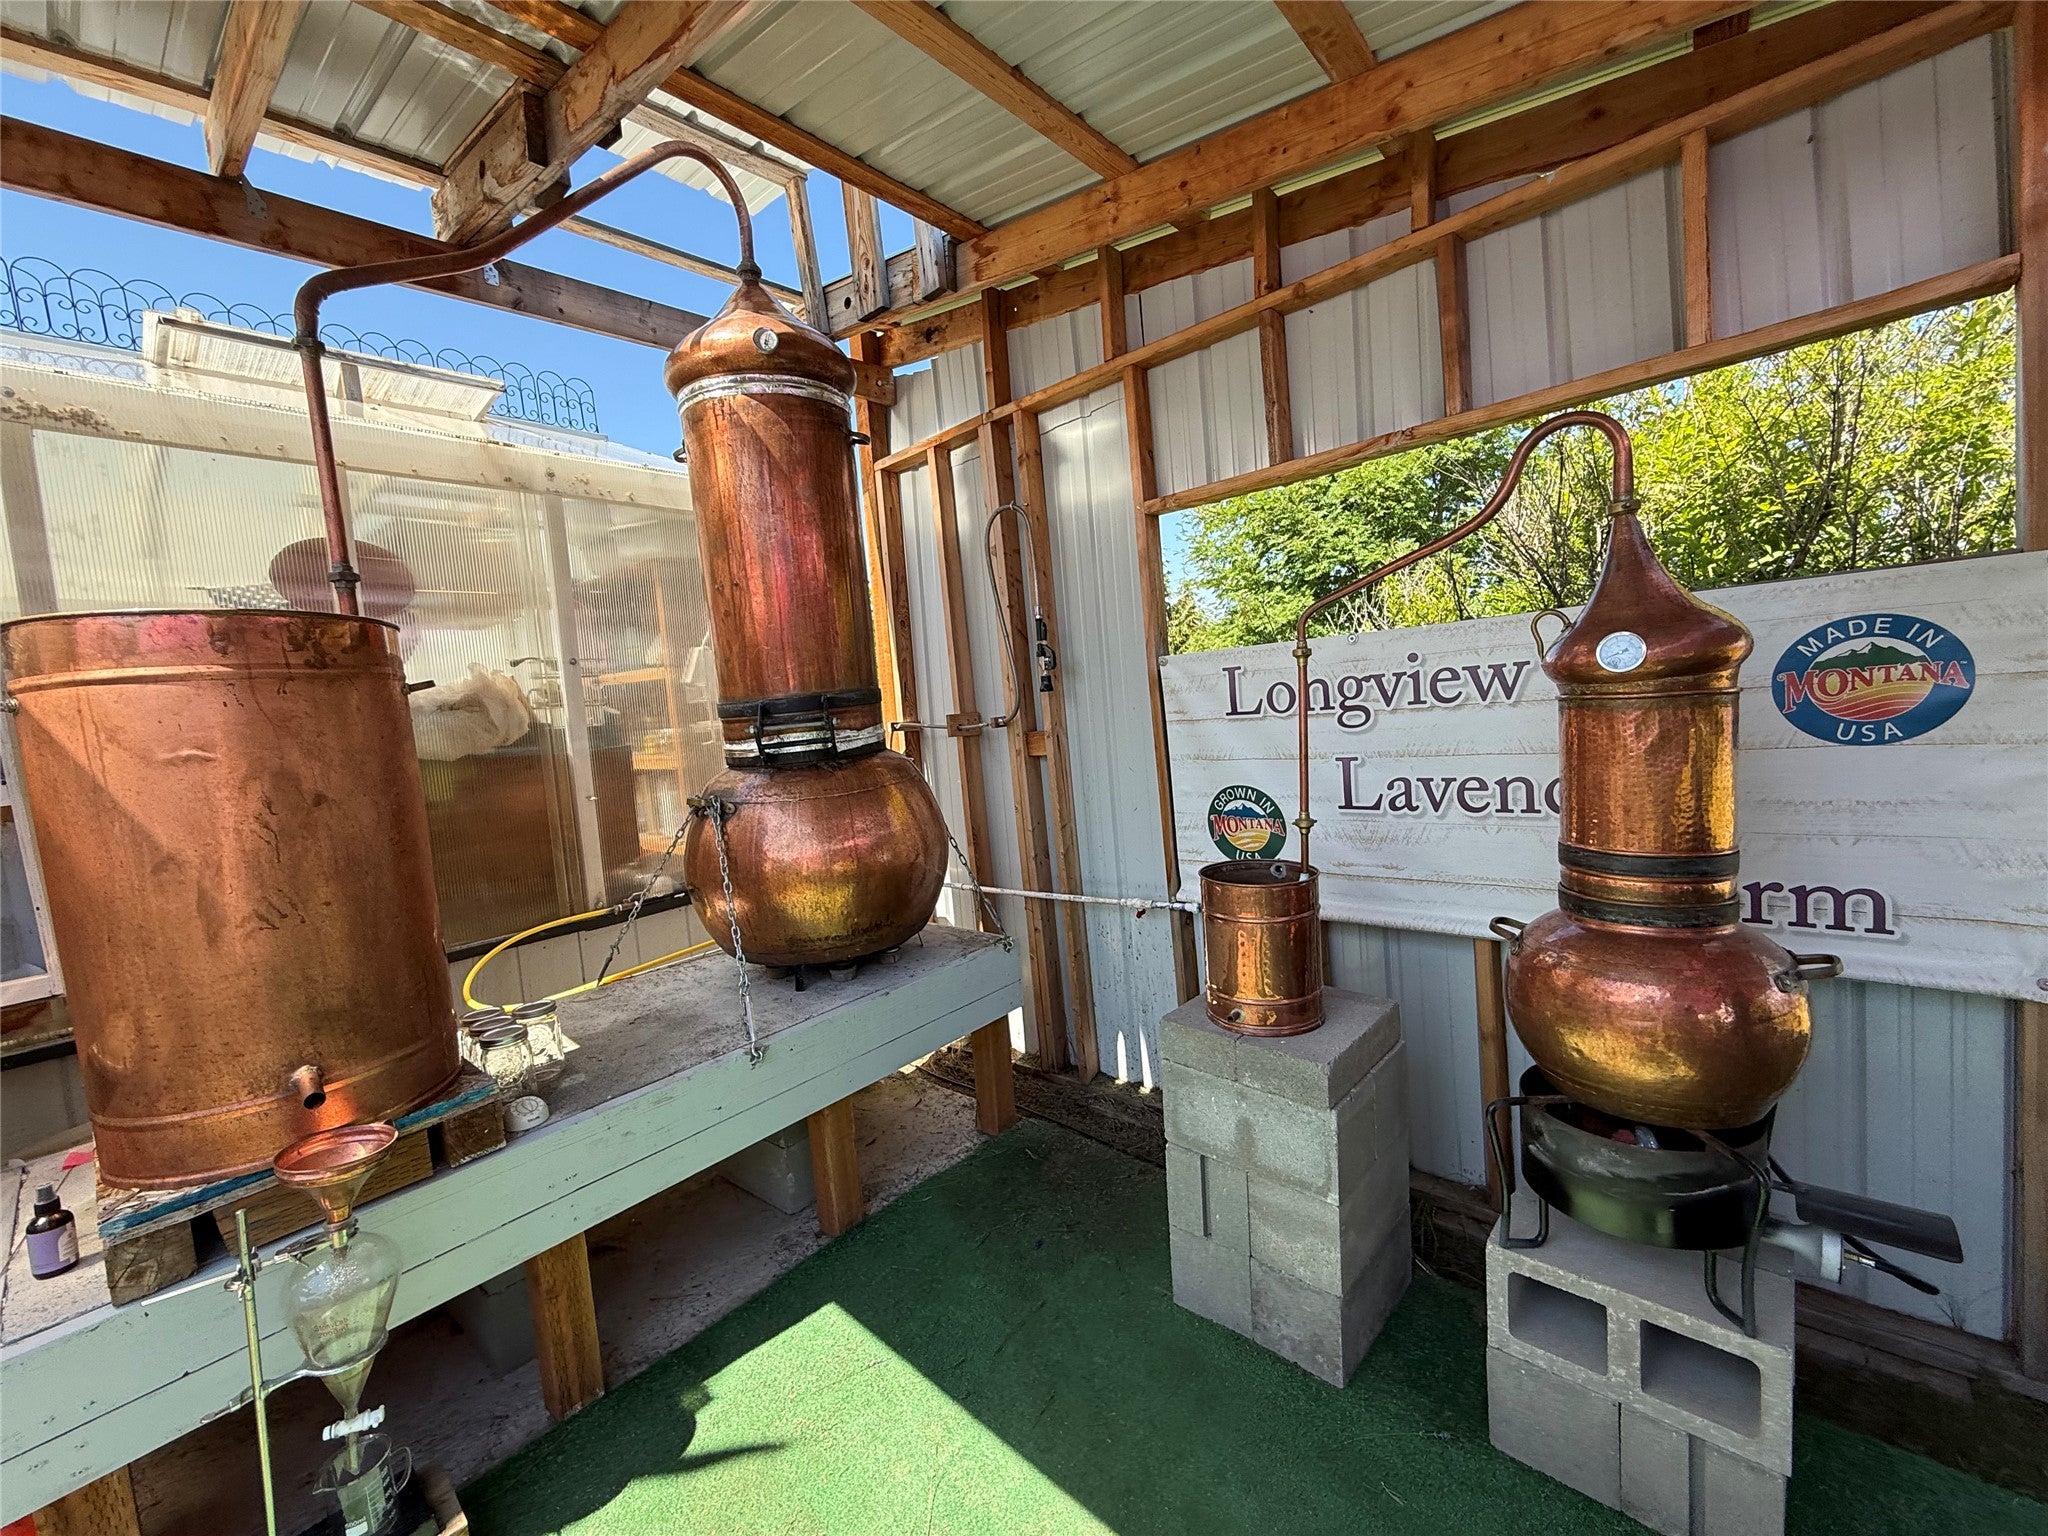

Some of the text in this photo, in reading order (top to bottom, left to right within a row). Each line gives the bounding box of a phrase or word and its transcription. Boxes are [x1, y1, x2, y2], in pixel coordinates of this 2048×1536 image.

[1797, 617, 1945, 657] MADE IN
[1222, 652, 1531, 729] Longview
[1776, 660, 1970, 714] MONTANA
[1836, 722, 1903, 742] USA
[1214, 787, 1275, 814] GROWN IN
[1209, 814, 1286, 841] MONTANA
[1742, 882, 1895, 936] rm
